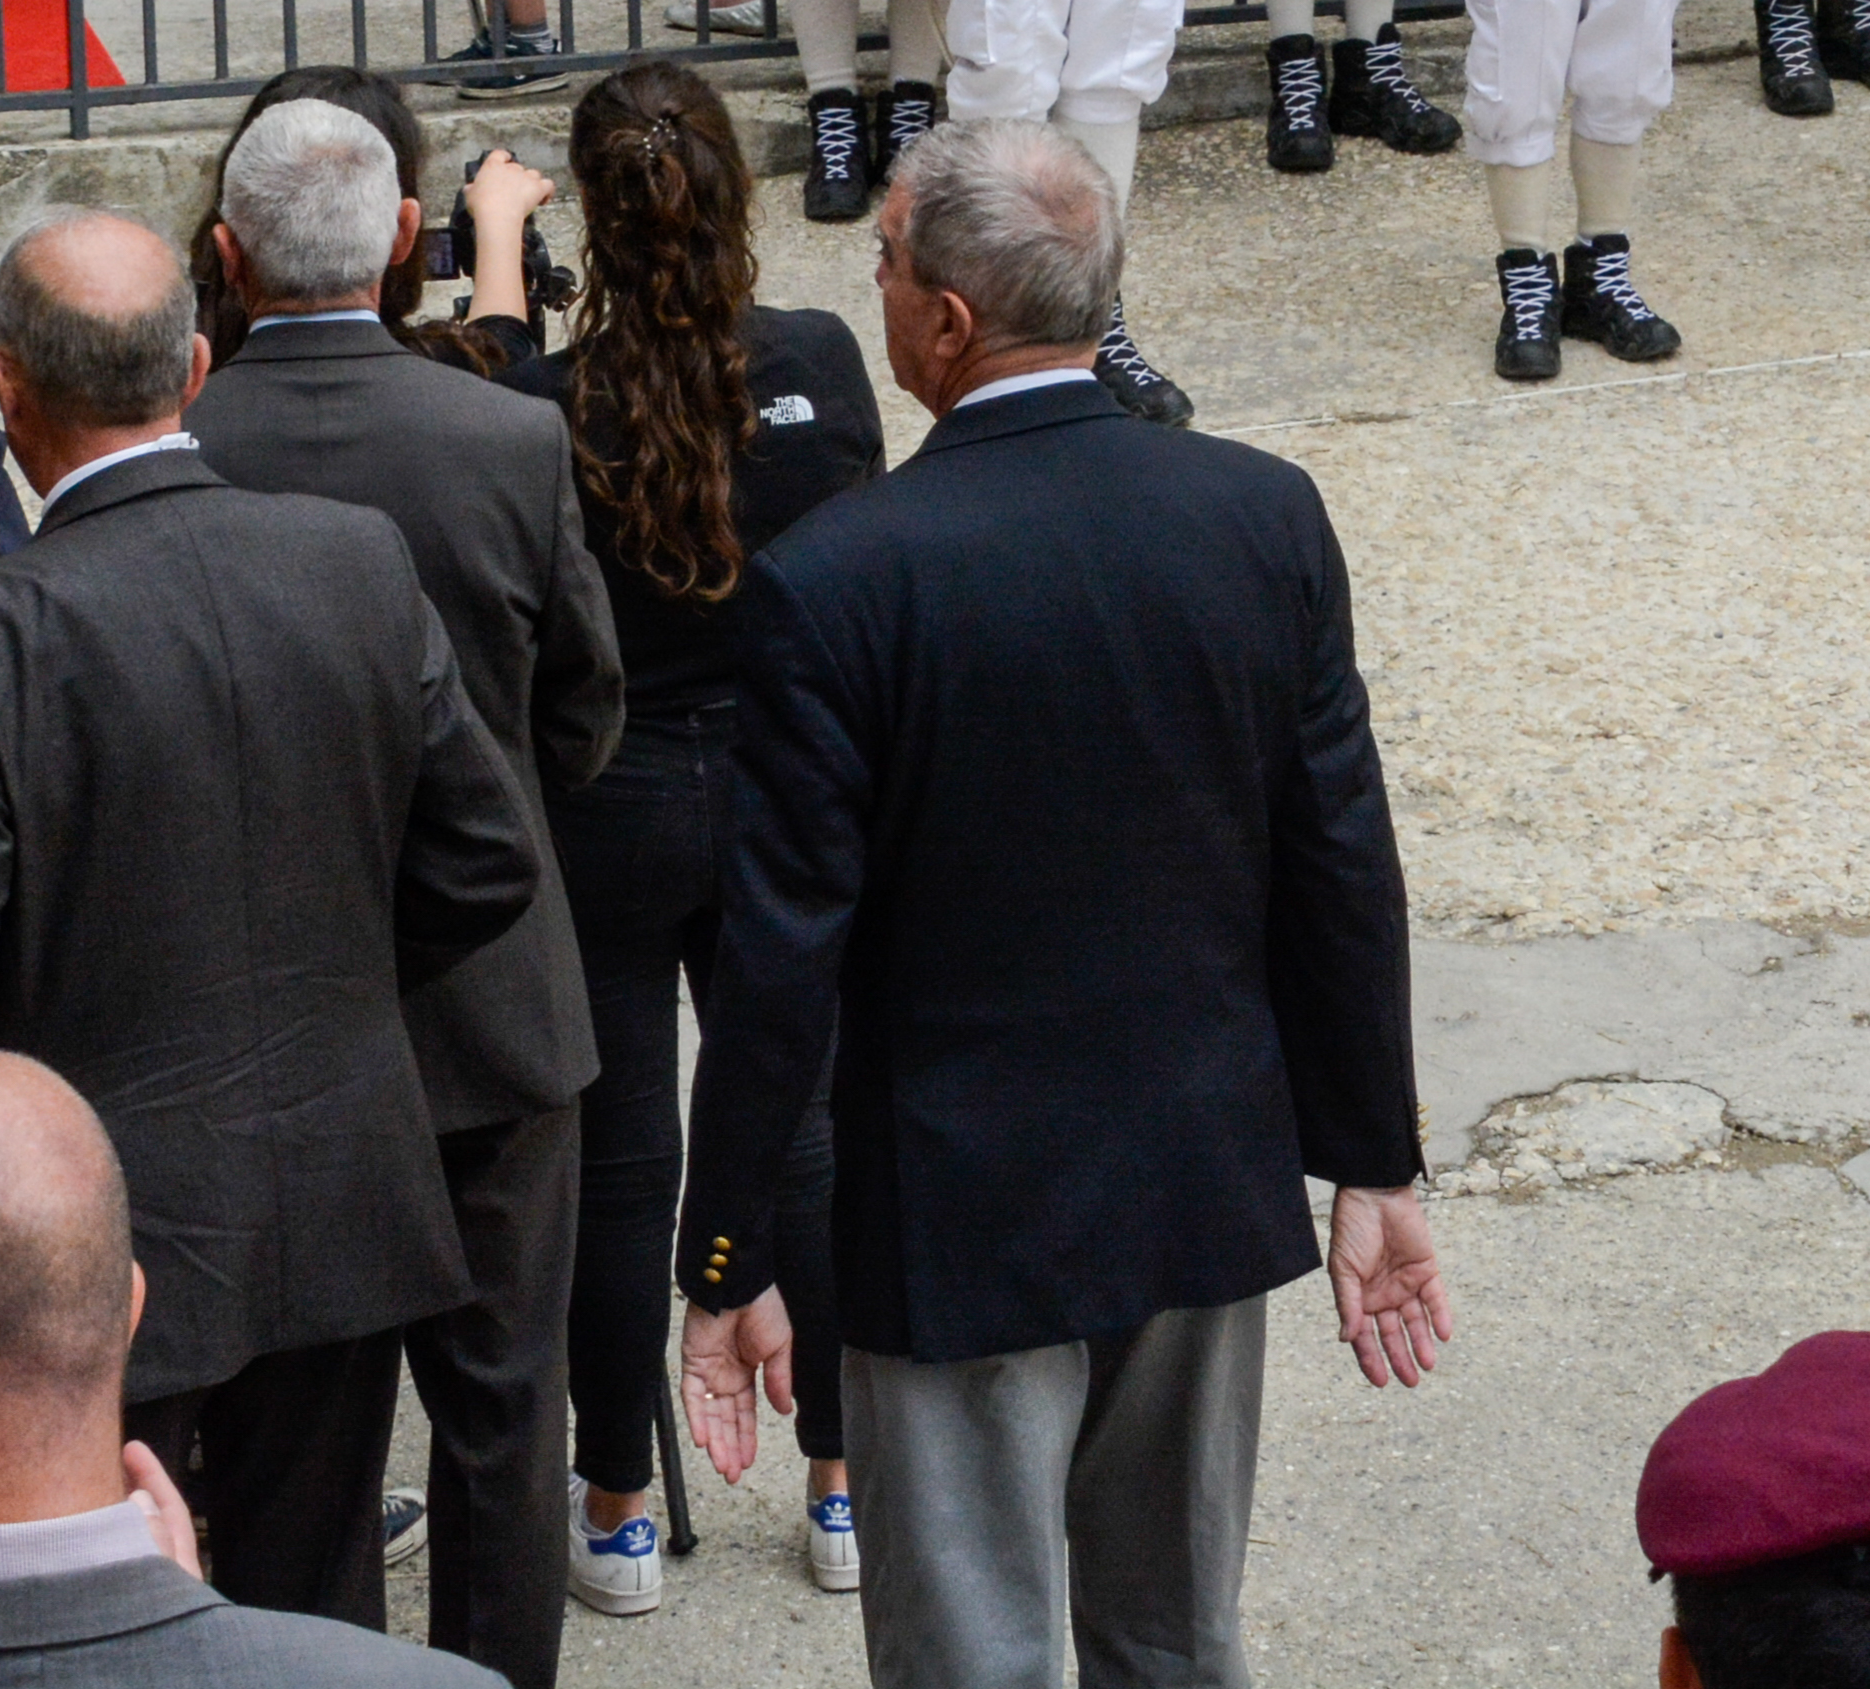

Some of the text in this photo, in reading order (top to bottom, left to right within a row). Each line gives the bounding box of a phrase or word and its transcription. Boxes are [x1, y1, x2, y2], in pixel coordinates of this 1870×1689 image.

[774, 397, 795, 408] THE
[760, 406, 795, 419] NORTH
[770, 415, 796, 426] FACE
